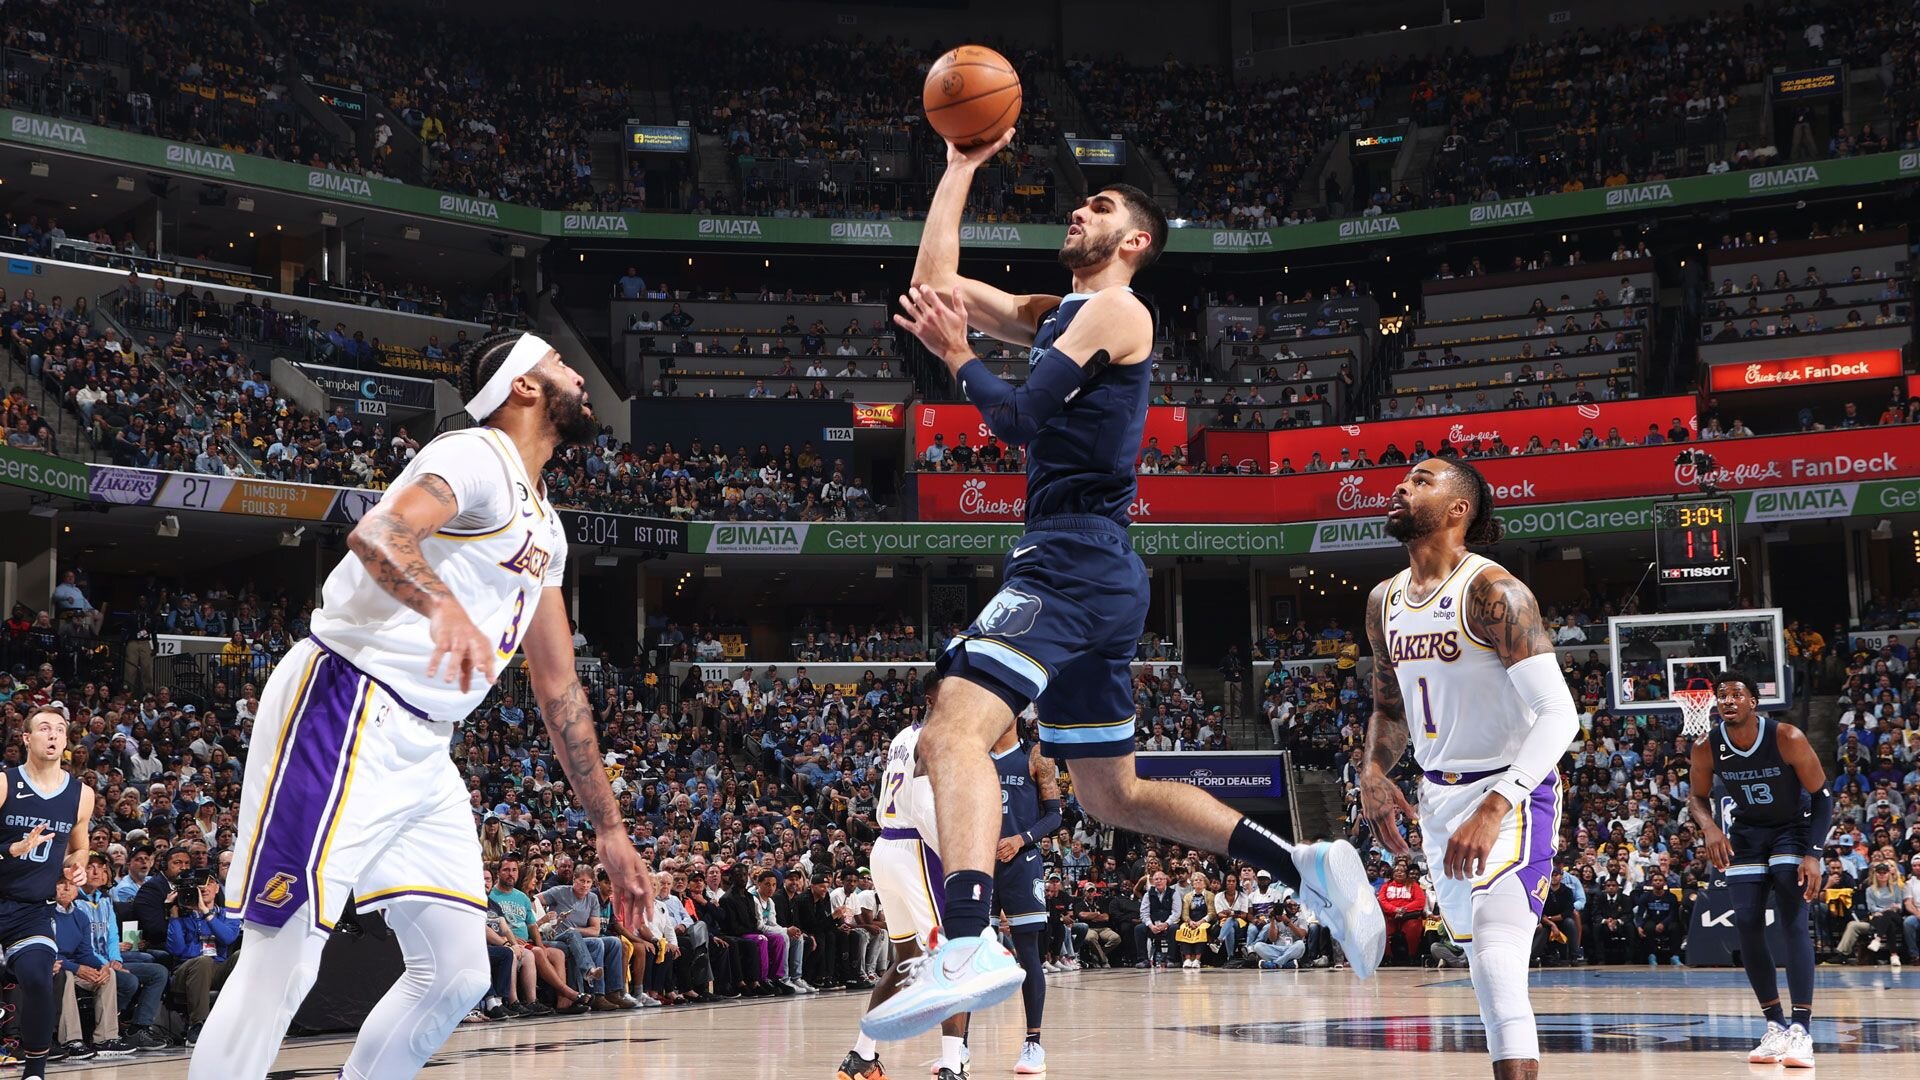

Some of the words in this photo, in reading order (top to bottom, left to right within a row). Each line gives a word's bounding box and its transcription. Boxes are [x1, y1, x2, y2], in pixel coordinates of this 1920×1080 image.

[32, 121, 87, 145] MATA
[1355, 136, 1403, 147] FedExForum
[185, 147, 236, 172] MATA
[1767, 166, 1819, 186] MATA
[325, 174, 372, 197] MATA
[1623, 184, 1673, 204] MATA
[455, 199, 499, 219] MATA
[1487, 201, 1534, 220] MATA
[581, 215, 628, 231] MATA
[715, 219, 762, 235] MATA
[847, 222, 893, 238] MATA
[1355, 217, 1401, 235] MATA
[976, 226, 1021, 241] MATA
[1228, 231, 1273, 246] MATA
[1804, 361, 1869, 379] FanDeck
[315, 376, 360, 392] Campbell
[378, 384, 404, 397] Clinic
[360, 401, 385, 414] 112A
[859, 408, 893, 417] SONIC
[828, 429, 851, 440] 112A
[1791, 452, 1898, 478] FanDeck
[92, 473, 157, 498] LAKERS
[182, 477, 211, 508] 27
[242, 484, 299, 501] TIMEOUTS:
[301, 489, 308, 502] 7
[241, 500, 279, 516] FOULS:
[280, 504, 288, 516] 2
[1780, 488, 1847, 511] MATA
[1680, 507, 1723, 528] 3:04
[577, 515, 619, 544] 3:04
[655, 528, 679, 545] QTR
[738, 526, 798, 545] MATA
[1341, 521, 1388, 541] MAT
[827, 530, 869, 549] Get
[871, 534, 921, 553] your
[925, 533, 996, 549] career
[1132, 531, 1180, 555] right
[1184, 531, 1285, 550] direction!
[1681, 566, 1731, 578] TISSOT
[497, 589, 525, 659] 3
[1433, 610, 1456, 620] bibigo
[1388, 629, 1462, 668] LAKERS
[705, 669, 722, 680] 111
[1290, 666, 1301, 677] 11
[1418, 676, 1438, 739] 1
[1719, 744, 1726, 752] 6
[1193, 769, 1209, 777] Ford
[1198, 777, 1226, 786] FORD
[1227, 776, 1272, 786] DEALERS
[1721, 766, 1782, 781] GRIZZLIES
[17, 781, 24, 789] 6
[1741, 783, 1775, 805] 13
[5, 814, 73, 834] GRIZZLIES
